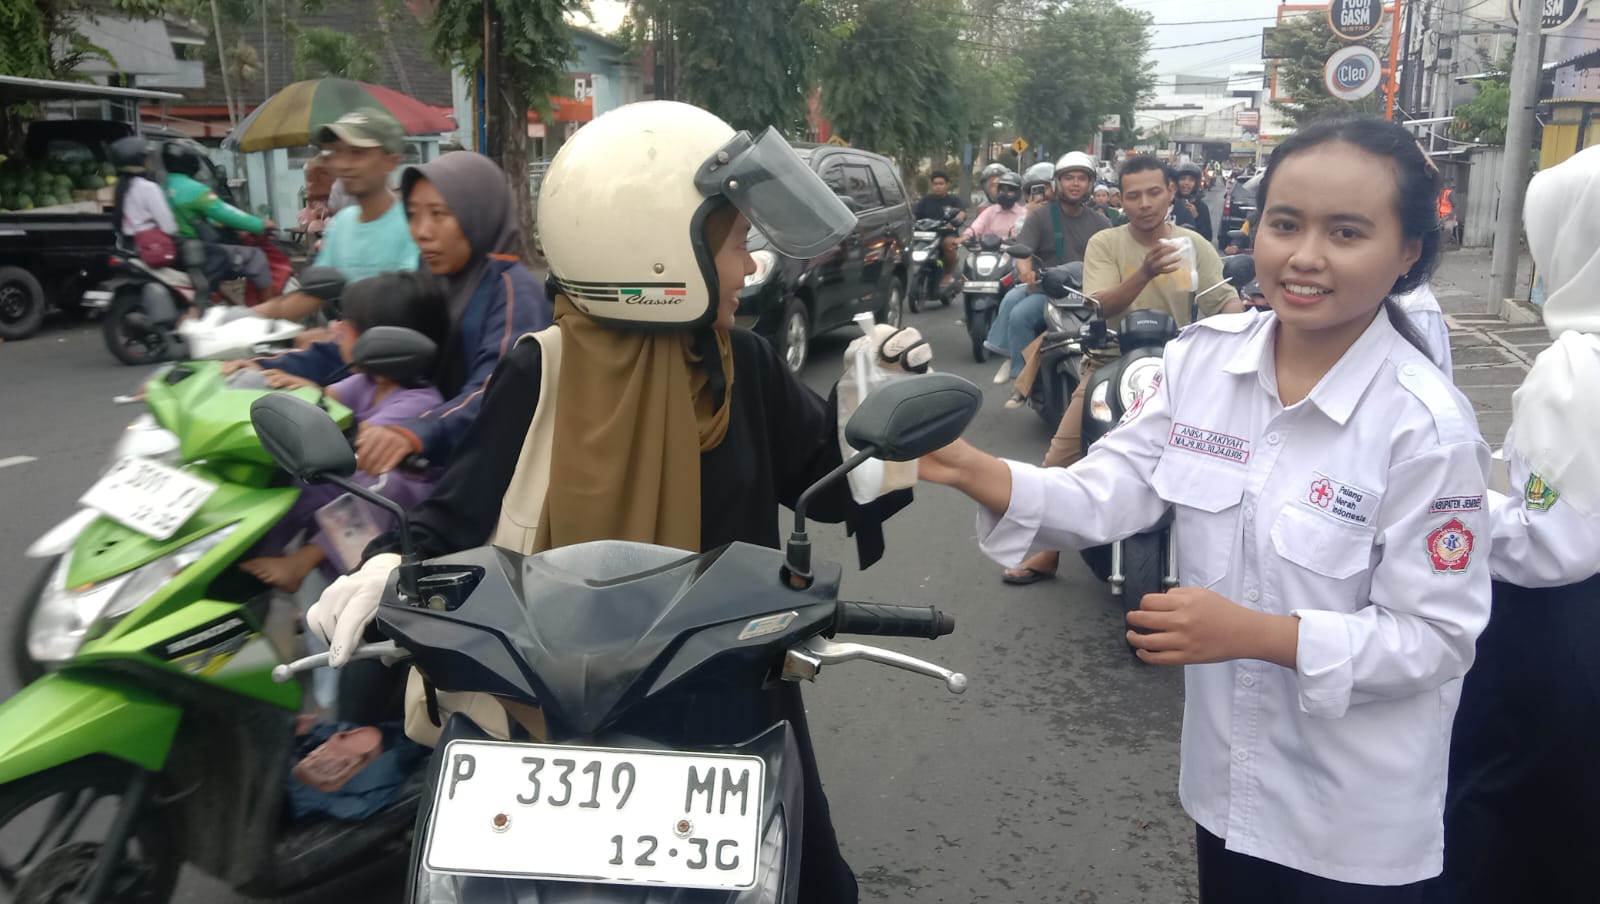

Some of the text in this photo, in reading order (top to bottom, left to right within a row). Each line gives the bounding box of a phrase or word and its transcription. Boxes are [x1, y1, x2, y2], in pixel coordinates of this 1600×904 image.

[1340, 8, 1370, 26] GASM
[1340, 65, 1366, 82] Cleo
[625, 294, 684, 306] Classic
[1180, 427, 1244, 449] ANISA ZAKIYAH
[1338, 486, 1364, 503] Palang
[1335, 496, 1358, 511] Merah
[1332, 505, 1367, 523] Indonesia
[448, 754, 751, 816] P 3319 MM
